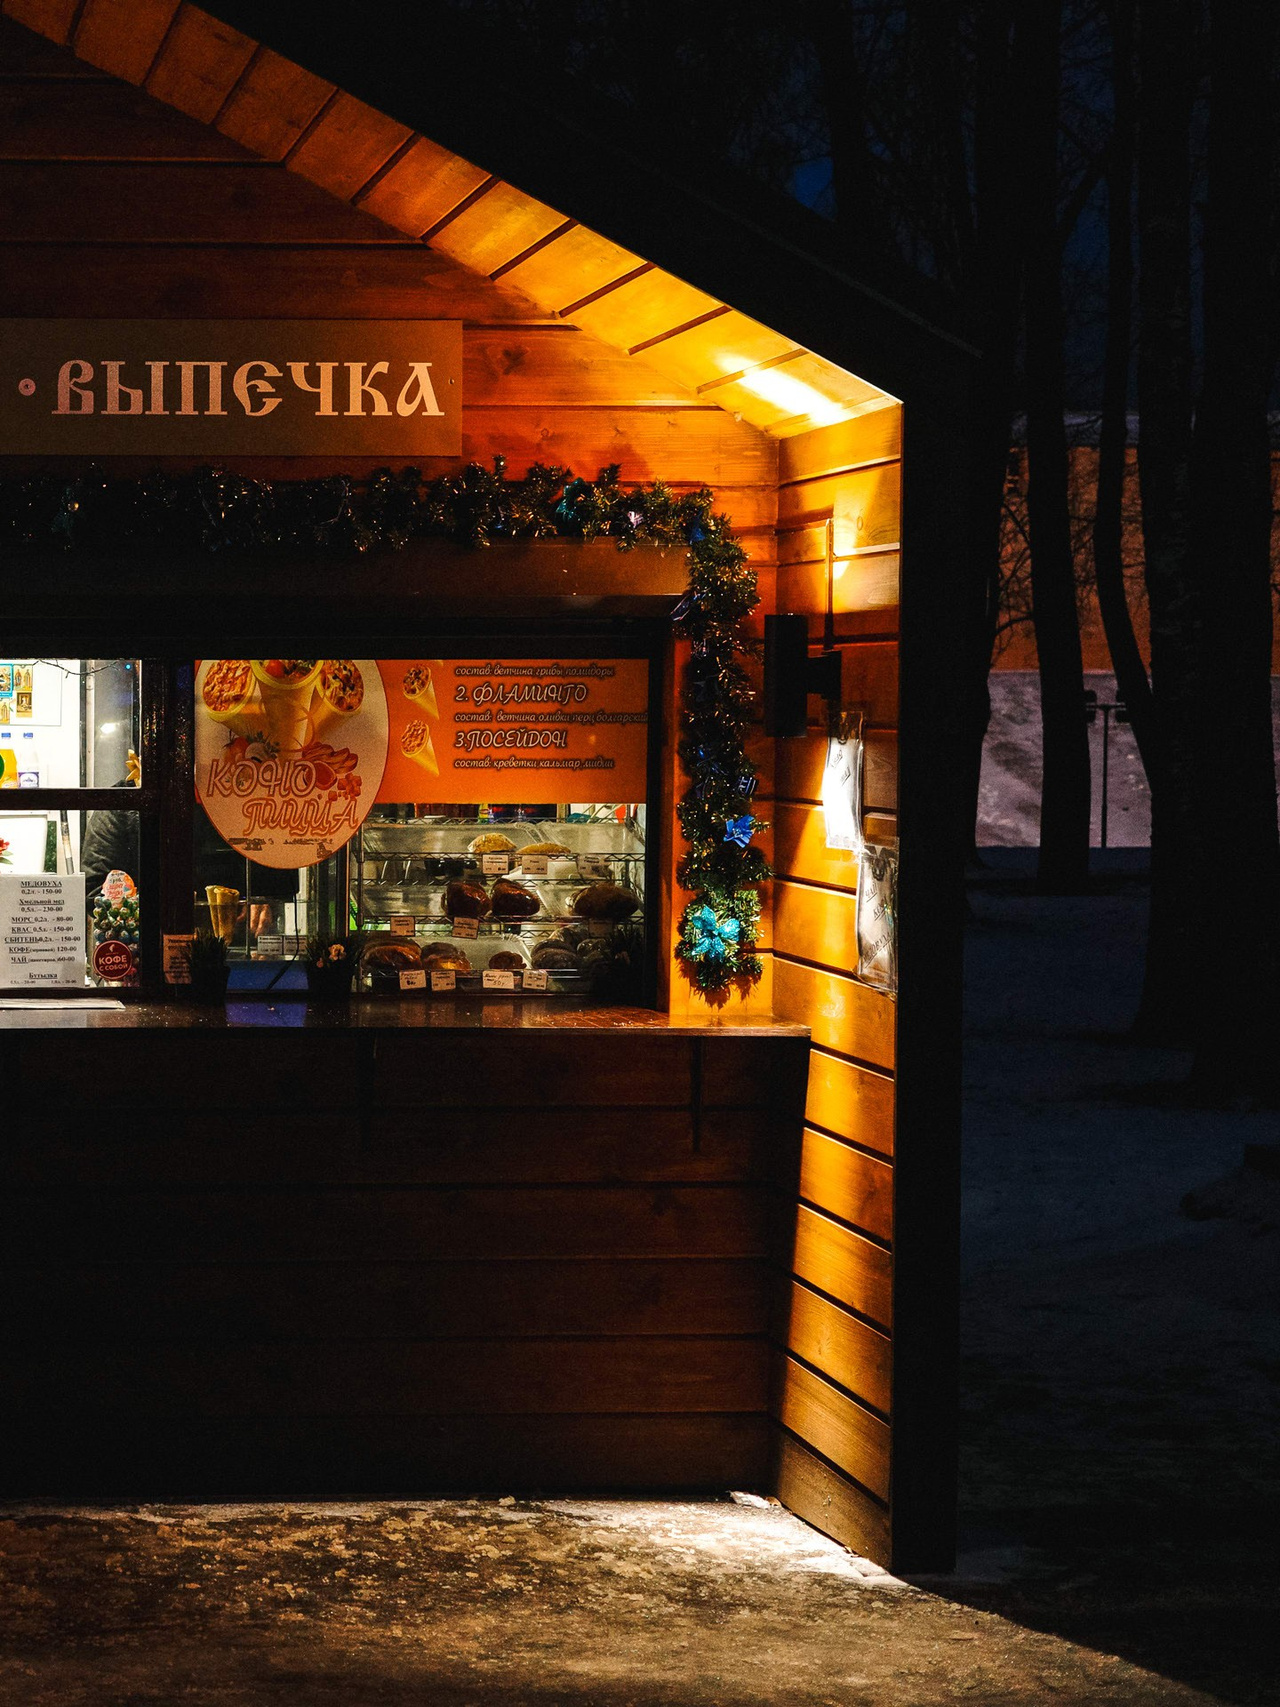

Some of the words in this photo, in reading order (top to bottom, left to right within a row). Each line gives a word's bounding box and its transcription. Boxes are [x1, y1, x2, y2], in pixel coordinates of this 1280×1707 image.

[50, 359, 446, 418] ВЫПЕЧКА
[455, 685, 469, 701] 2.
[472, 682, 588, 706] ФЛАМИНГО
[206, 759, 318, 798] КОНО
[242, 796, 360, 837] ПИЦЦА
[20, 880, 62, 888] МЕДОВУХА
[98, 954, 128, 965] КОФЕ
[104, 963, 129, 971] СОБОЙ
